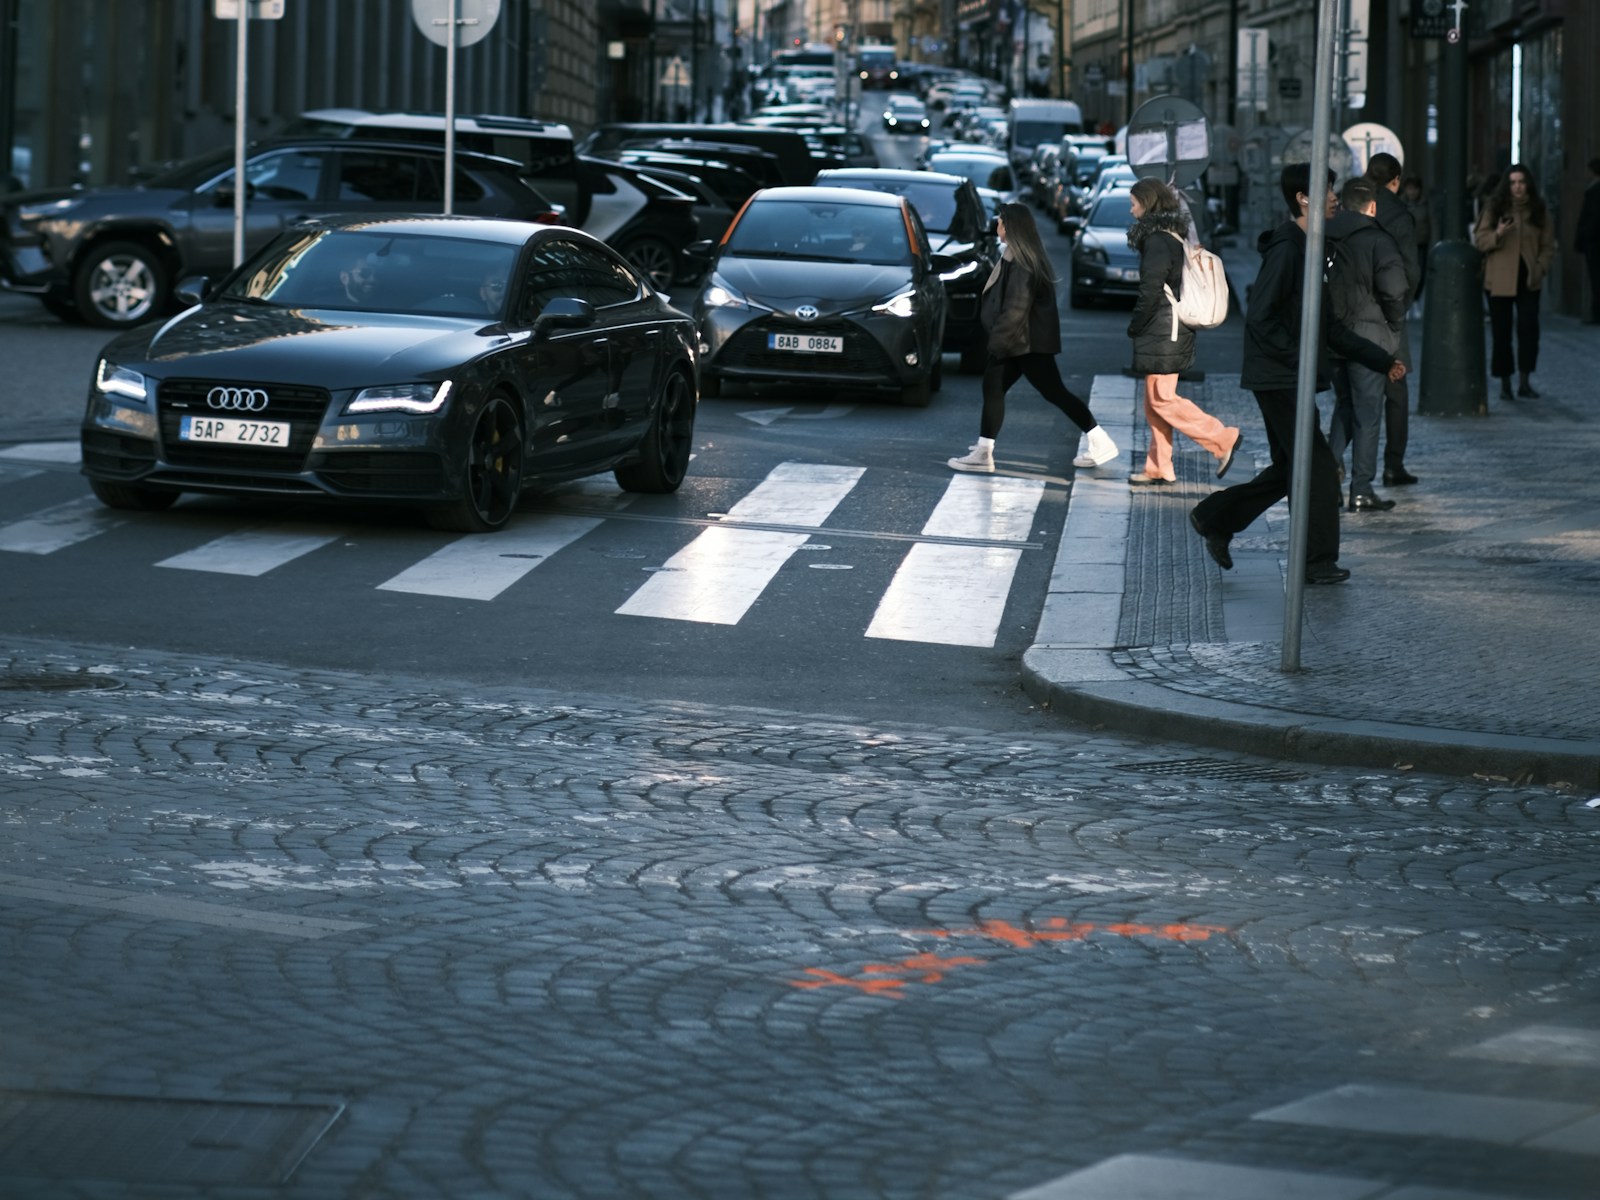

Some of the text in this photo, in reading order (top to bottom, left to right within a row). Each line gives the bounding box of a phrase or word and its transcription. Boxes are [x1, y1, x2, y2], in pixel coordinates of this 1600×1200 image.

[778, 336, 799, 349] 8AB
[808, 337, 837, 350] 0884
[194, 420, 281, 444] 5AP 2732
